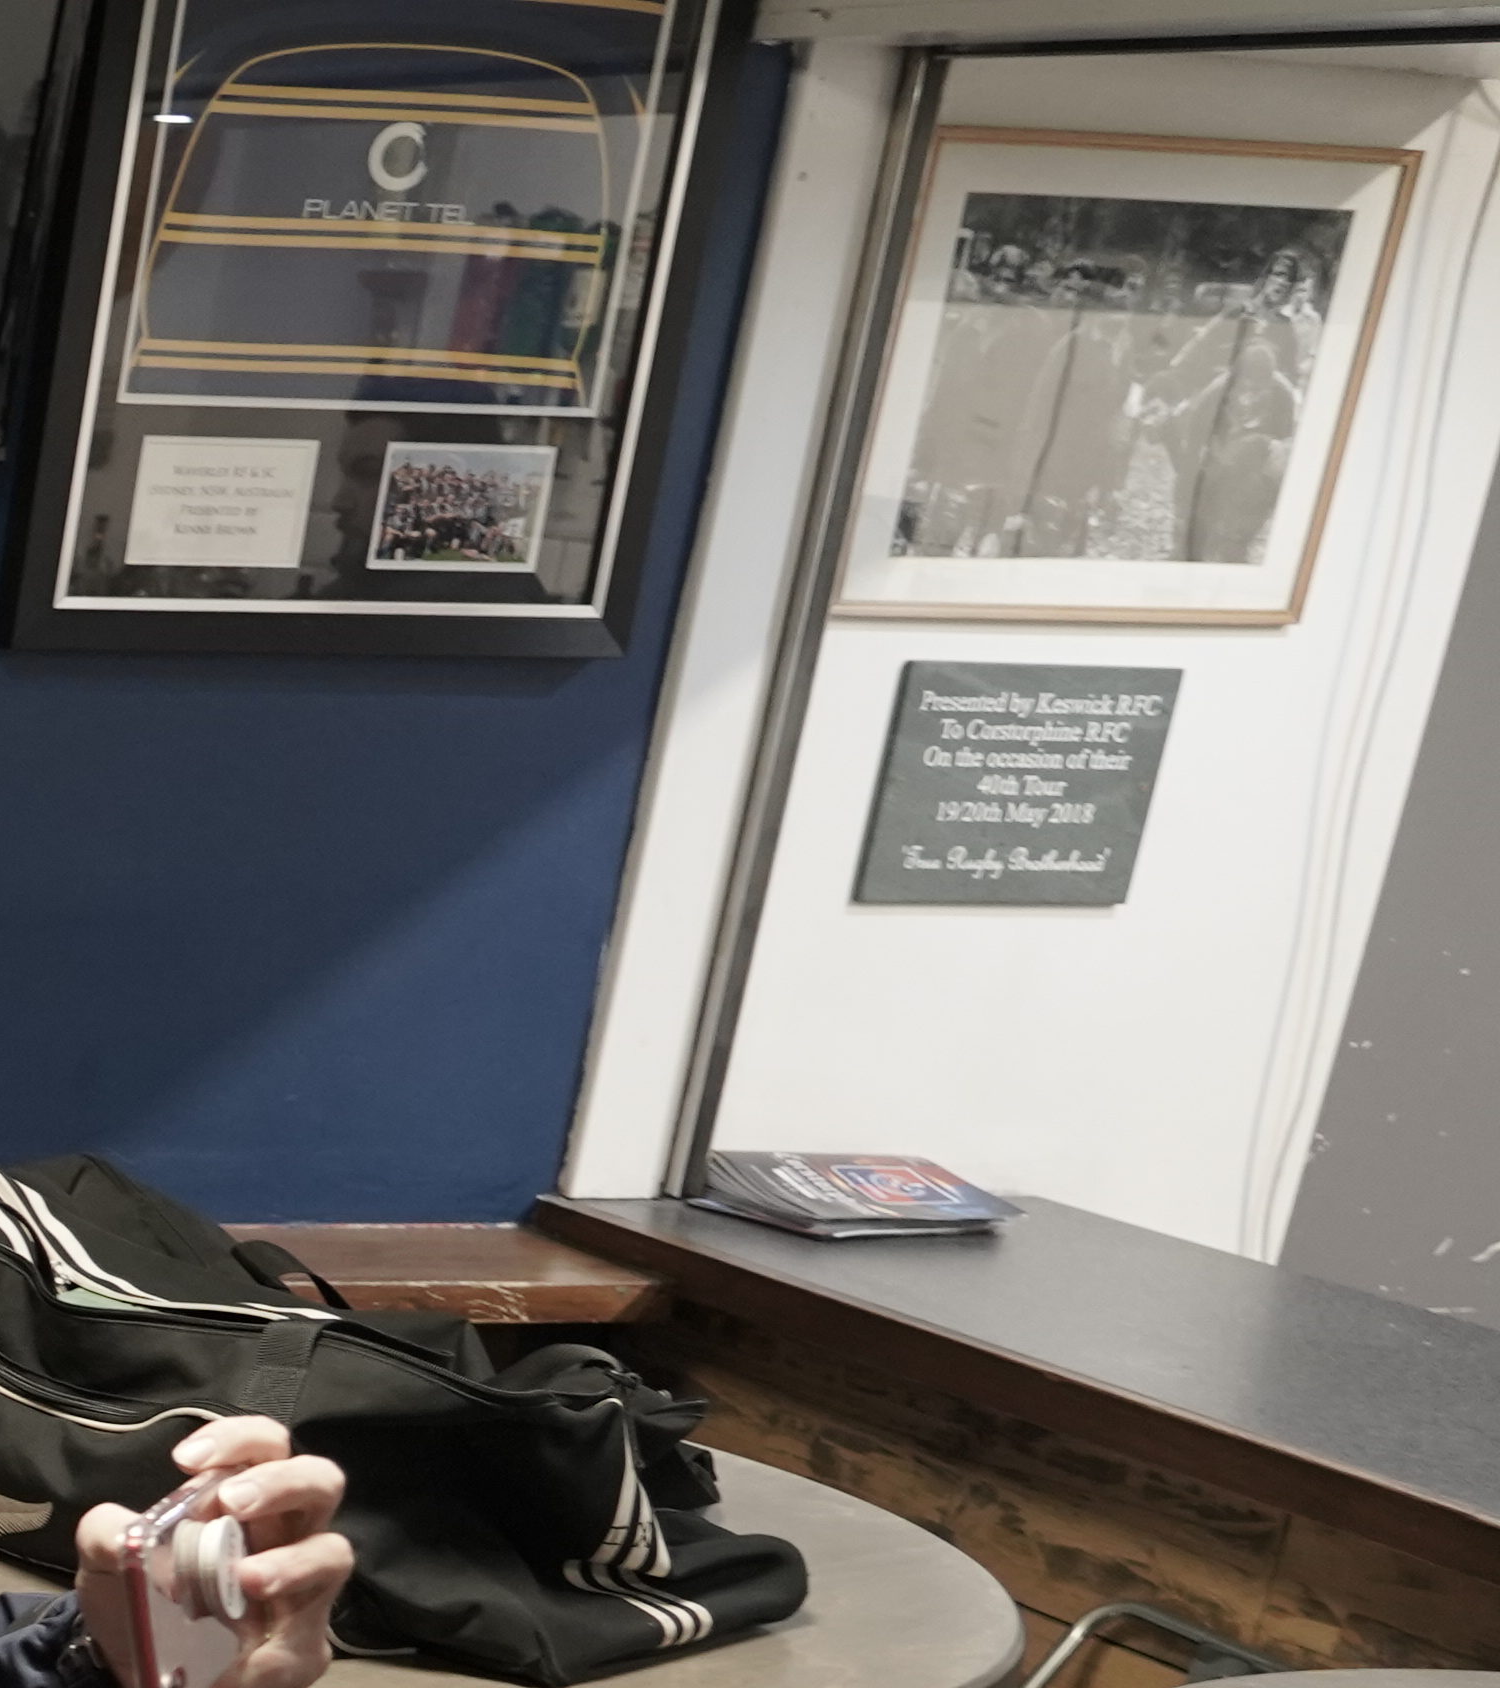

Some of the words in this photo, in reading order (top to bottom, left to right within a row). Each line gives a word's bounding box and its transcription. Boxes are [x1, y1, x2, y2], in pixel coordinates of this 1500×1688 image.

[303, 198, 419, 221] PLANET
[920, 690, 1010, 714] Presented
[1009, 692, 1036, 719] by
[1036, 692, 1114, 716] Keswick
[1114, 694, 1163, 717] RFC
[940, 718, 966, 741] To
[966, 718, 1085, 747] Corstorphine
[1083, 721, 1133, 744] RFC
[922, 745, 953, 769] On
[954, 746, 985, 769] the
[985, 748, 1064, 770] occasion
[1065, 748, 1093, 770] of
[1088, 749, 1134, 771] their
[976, 774, 1020, 797] 40th
[1022, 775, 1069, 798] Tour
[1004, 802, 1049, 829] May
[1048, 803, 1097, 825] 2018
[946, 845, 1005, 880] Rugby
